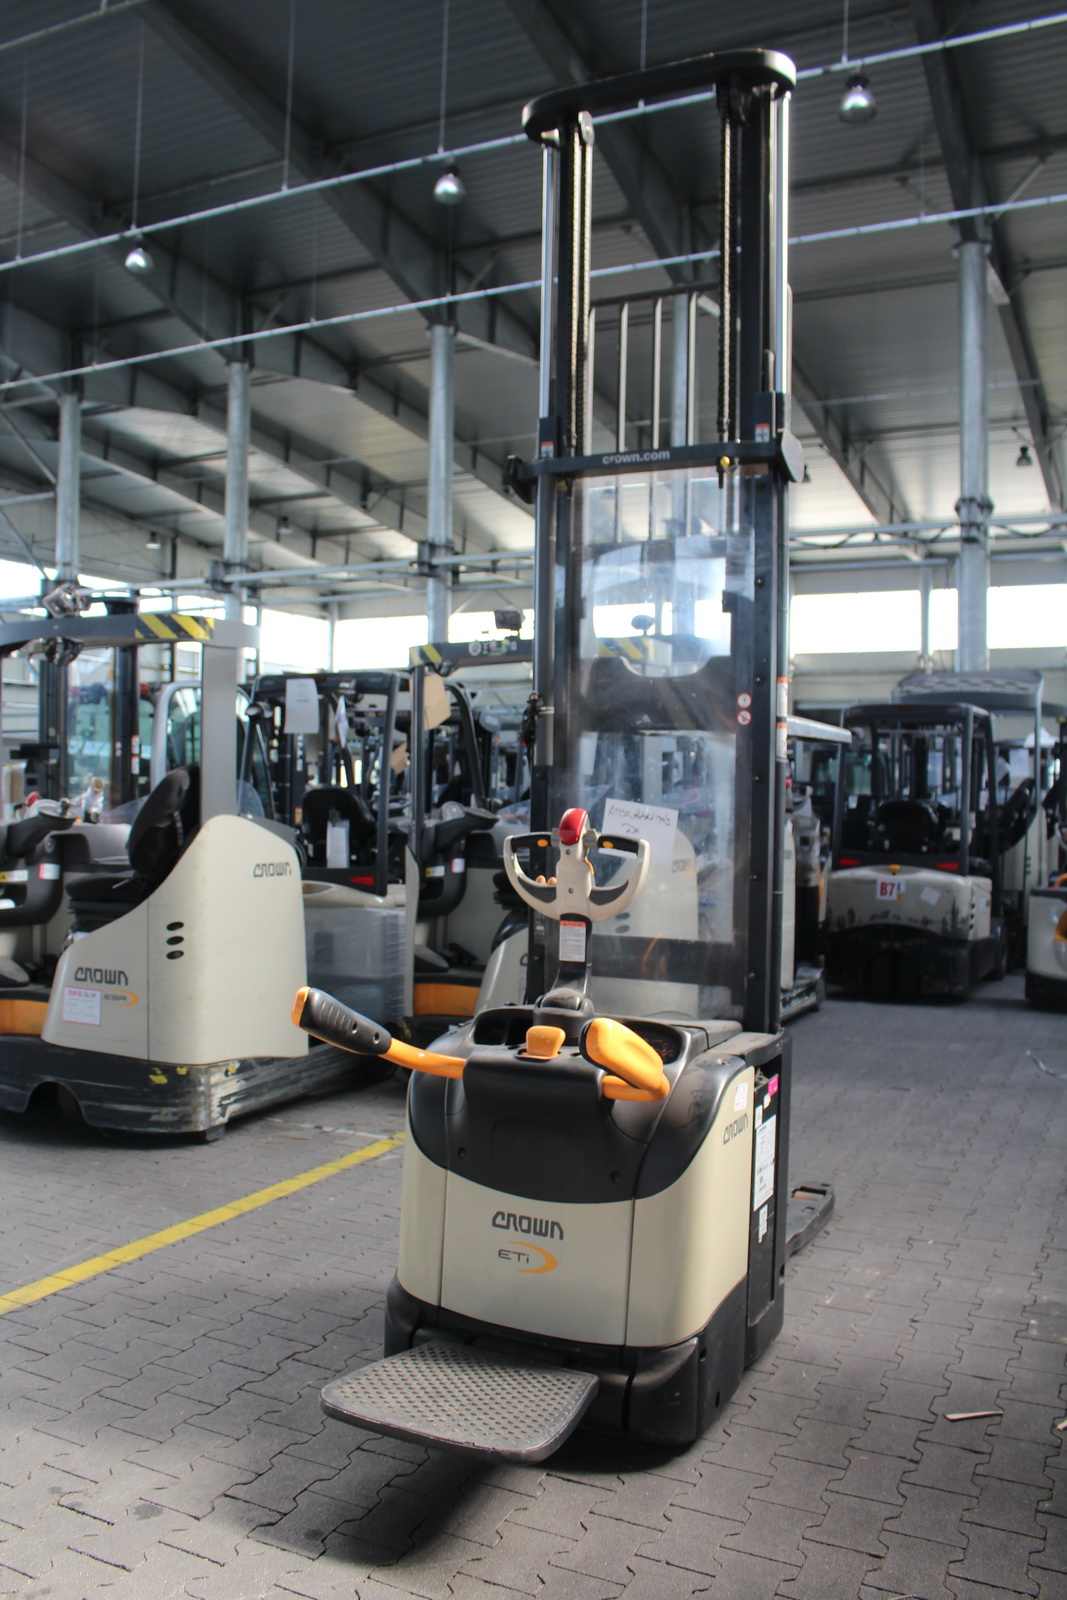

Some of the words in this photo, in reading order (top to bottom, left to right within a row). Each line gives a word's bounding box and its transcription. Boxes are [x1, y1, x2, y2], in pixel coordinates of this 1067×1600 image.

[602, 450, 670, 465] crown.com
[253, 862, 292, 877] CROWN
[74, 966, 129, 986] CROWN
[723, 1113, 749, 1145] CROWN
[492, 1210, 564, 1241] CROWN
[498, 1248, 530, 1264] ETi
